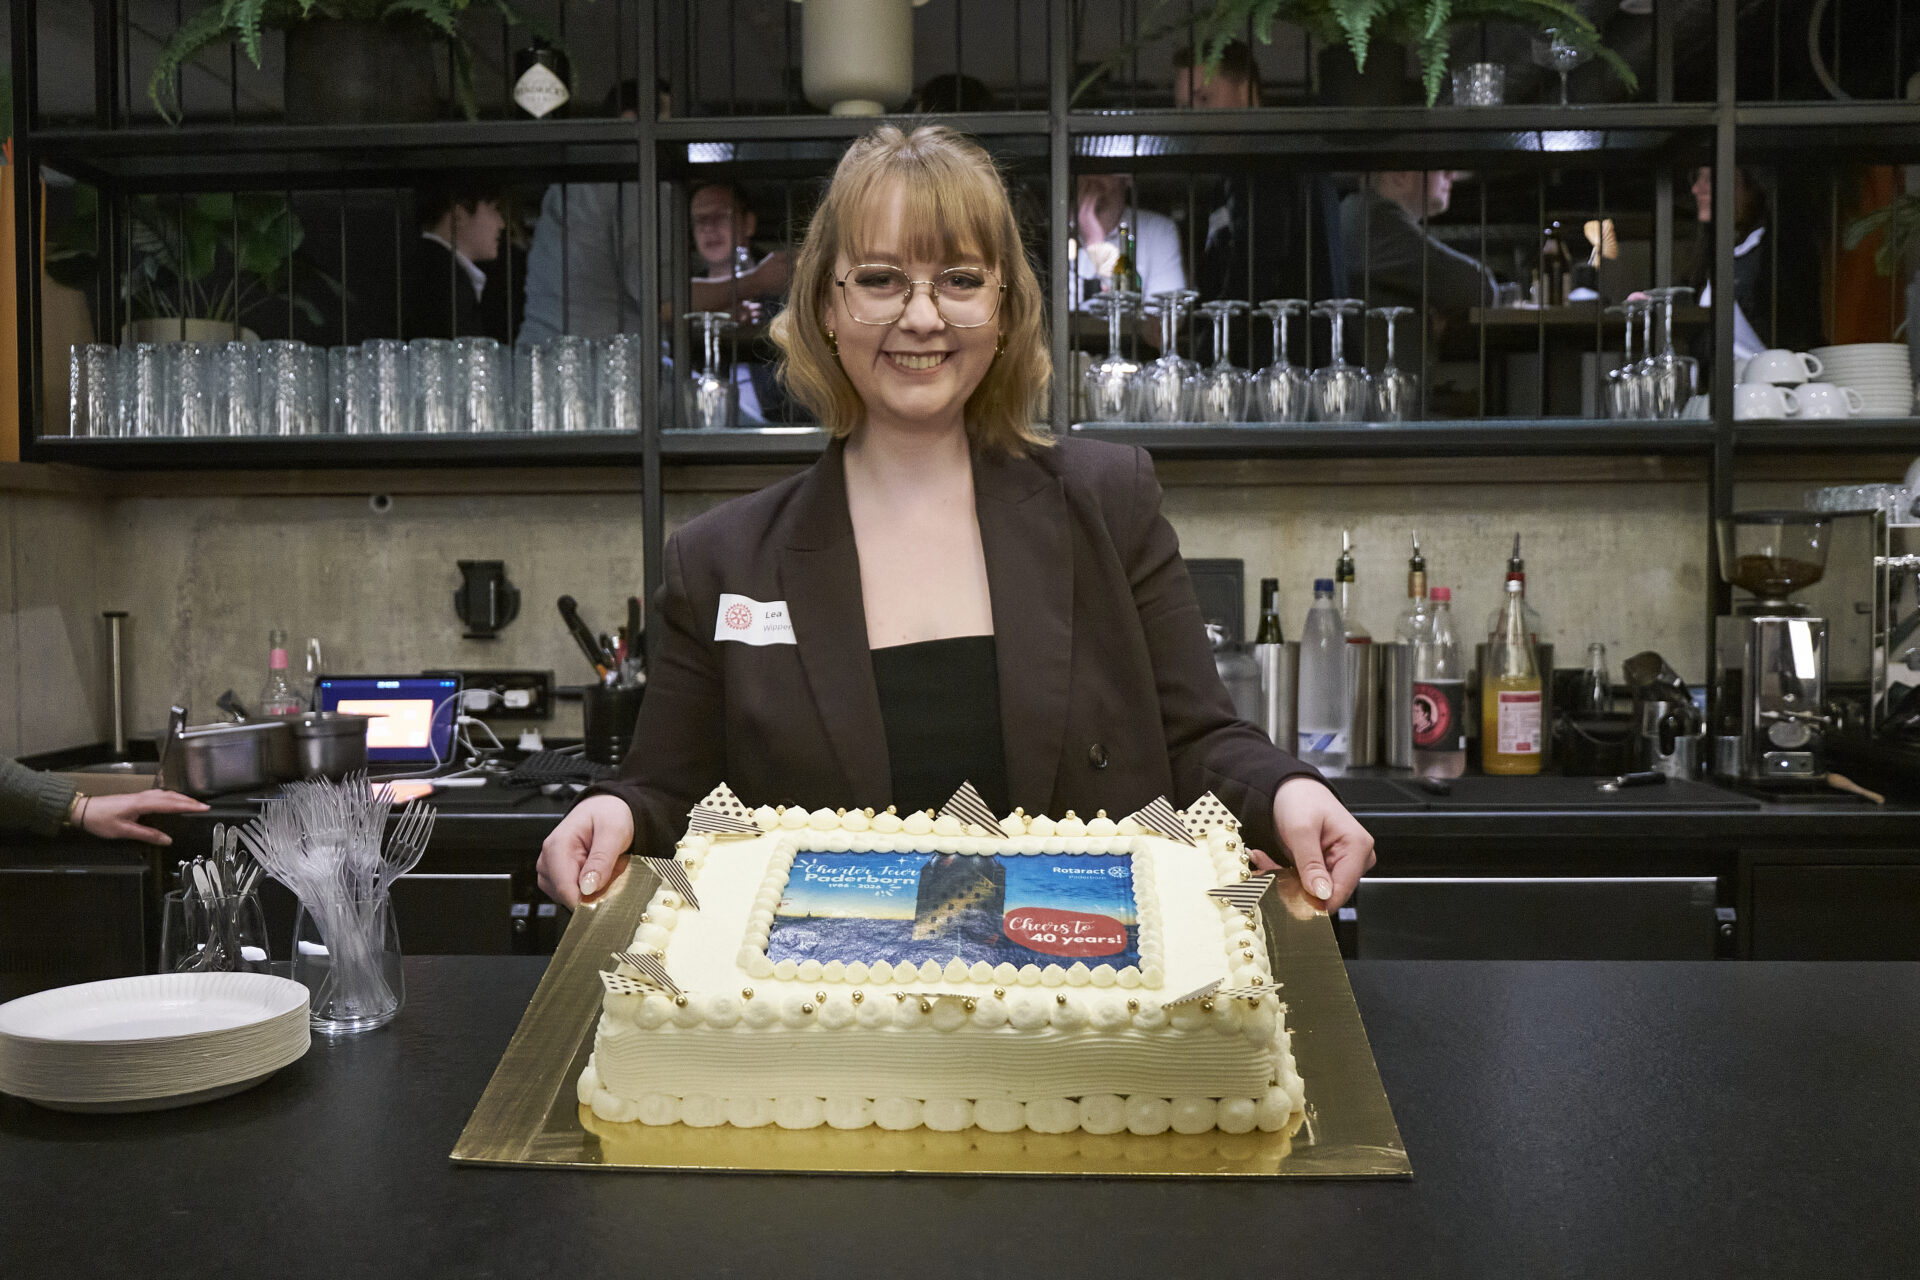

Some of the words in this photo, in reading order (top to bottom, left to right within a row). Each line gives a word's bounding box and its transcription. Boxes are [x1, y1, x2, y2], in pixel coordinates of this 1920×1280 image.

[765, 611, 782, 619] Lea
[1052, 866, 1106, 875] Rotaract
[804, 873, 915, 885] Paderborn
[1009, 916, 1069, 934] Cheers
[1069, 920, 1096, 934] to
[1030, 933, 1057, 943] 40
[1061, 935, 1122, 945] years!
